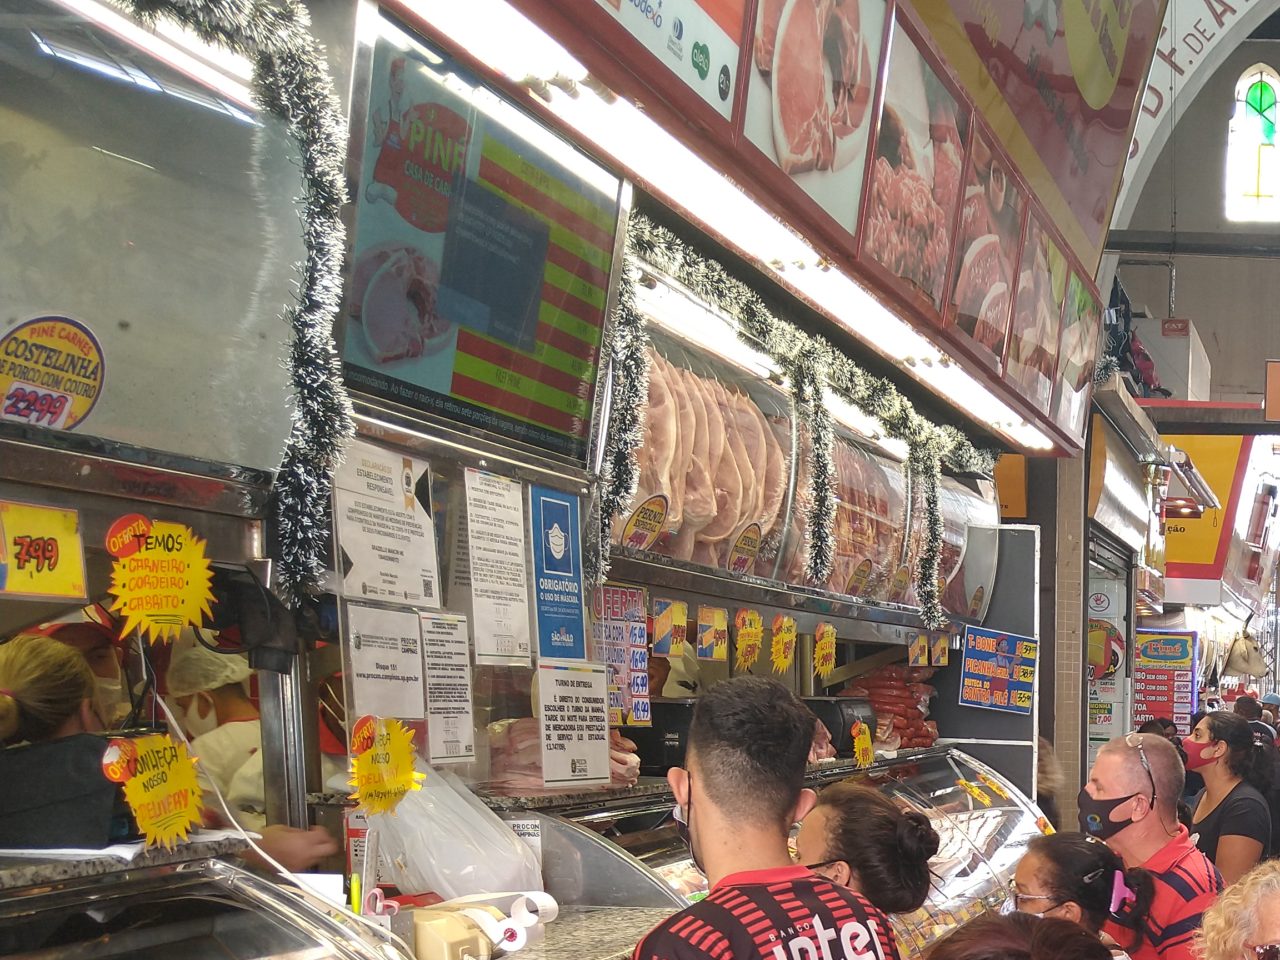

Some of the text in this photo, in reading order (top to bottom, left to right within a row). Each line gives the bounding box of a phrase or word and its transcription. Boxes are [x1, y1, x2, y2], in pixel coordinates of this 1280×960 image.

[1182, 18, 1216, 55] DE
[5, 336, 100, 382] COSTELINHA
[9, 361, 97, 399] PORCO COM COURO
[356, 468, 394, 485] ESTABELECIMENTO
[366, 482, 394, 497] RESPONSÁVEL
[638, 507, 663, 524] PERNIL
[109, 519, 148, 553] OFERTA
[132, 533, 184, 553] TEMOS
[128, 558, 186, 574] CARNEIRO
[128, 575, 185, 592] CORDEIRO
[539, 578, 579, 593] OBRIGATÓRIO
[128, 595, 180, 611] CABRITO
[544, 593, 552, 602] USO
[553, 594, 559, 602] DE
[593, 585, 646, 623] OFERTA
[401, 637, 418, 646] PROCON
[976, 635, 997, 653] BONE
[376, 662, 390, 671] Disque
[965, 658, 995, 676] PICANHA
[555, 679, 592, 688] TURNO DE ENTREGA
[963, 686, 1009, 706] CONTRA FILÉ
[352, 718, 376, 750] OFERTA
[585, 723, 605, 733] PRESTAÇÃO
[557, 734, 573, 742] SERVIÇO
[128, 746, 178, 778] CONHEÇA
[142, 771, 168, 793] NOSSO
[768, 922, 811, 942] BANCO
